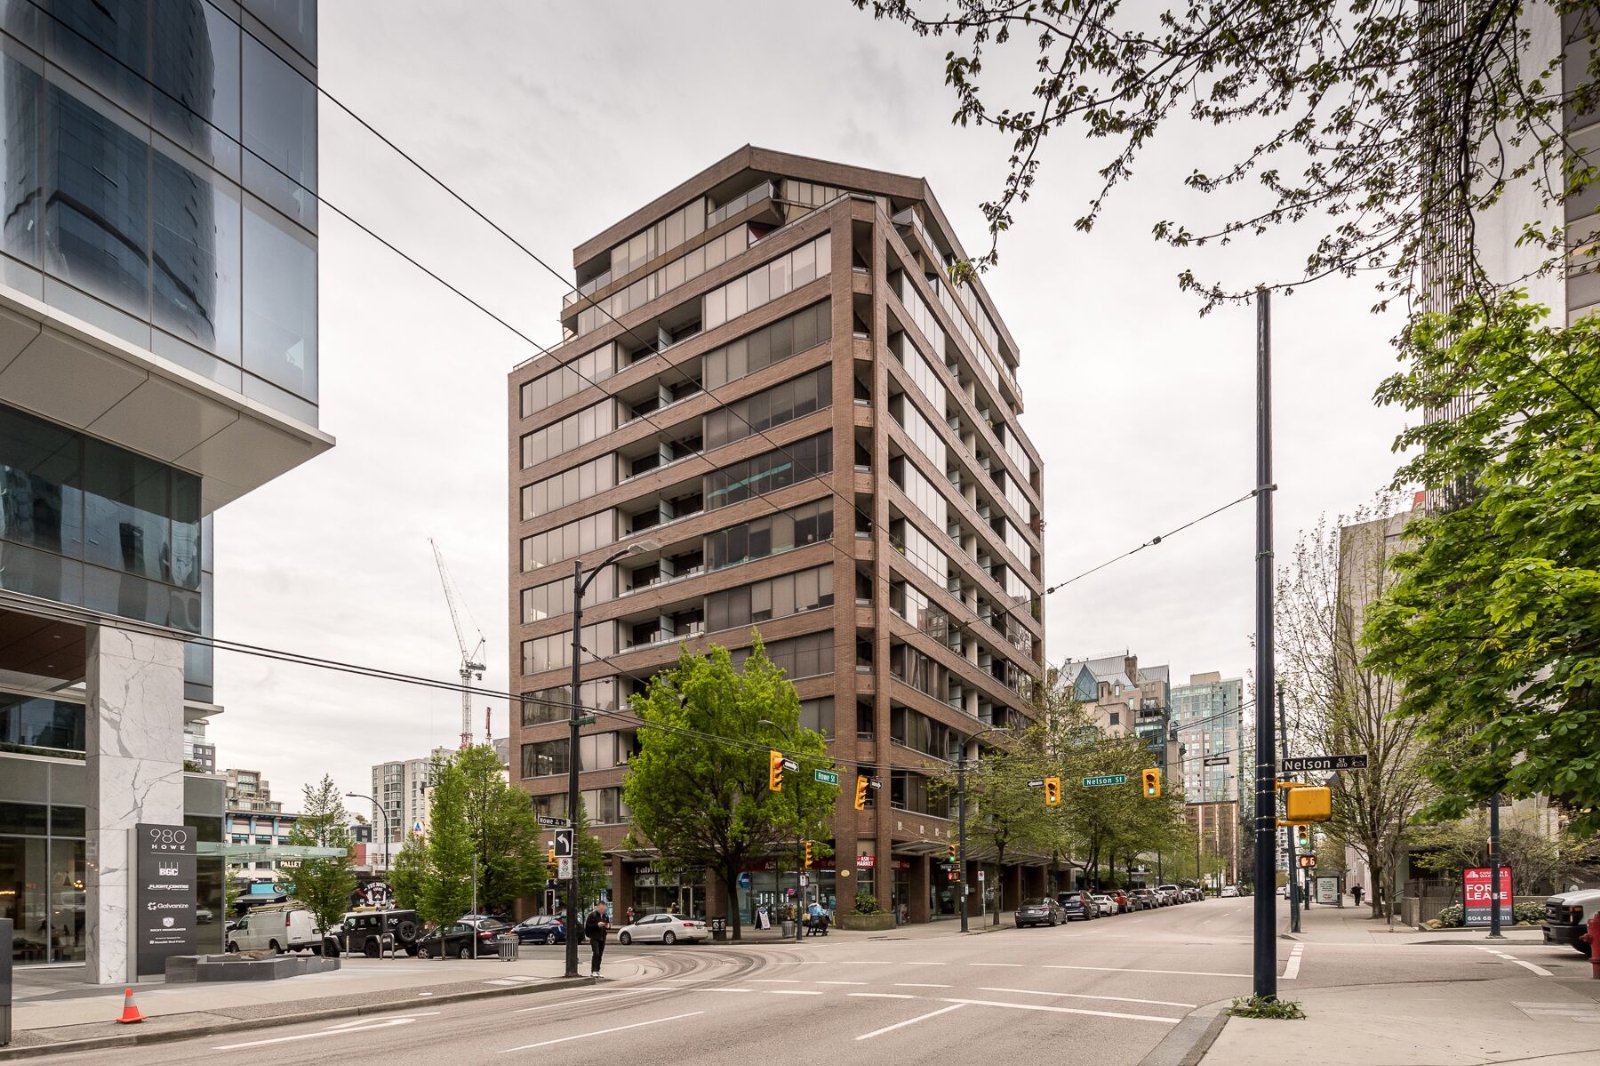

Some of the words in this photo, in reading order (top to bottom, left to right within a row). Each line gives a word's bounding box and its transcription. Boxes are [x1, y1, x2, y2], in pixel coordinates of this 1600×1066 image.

[1284, 759, 1331, 770] Nelson
[818, 772, 830, 782] Howe
[830, 774, 836, 783] St
[1086, 778, 1112, 786] Nelson
[150, 828, 187, 845] 980
[280, 860, 302, 868] PALLET
[159, 868, 179, 876] BGC
[1466, 884, 1492, 892] FOR
[1466, 891, 1508, 900] LEAE
